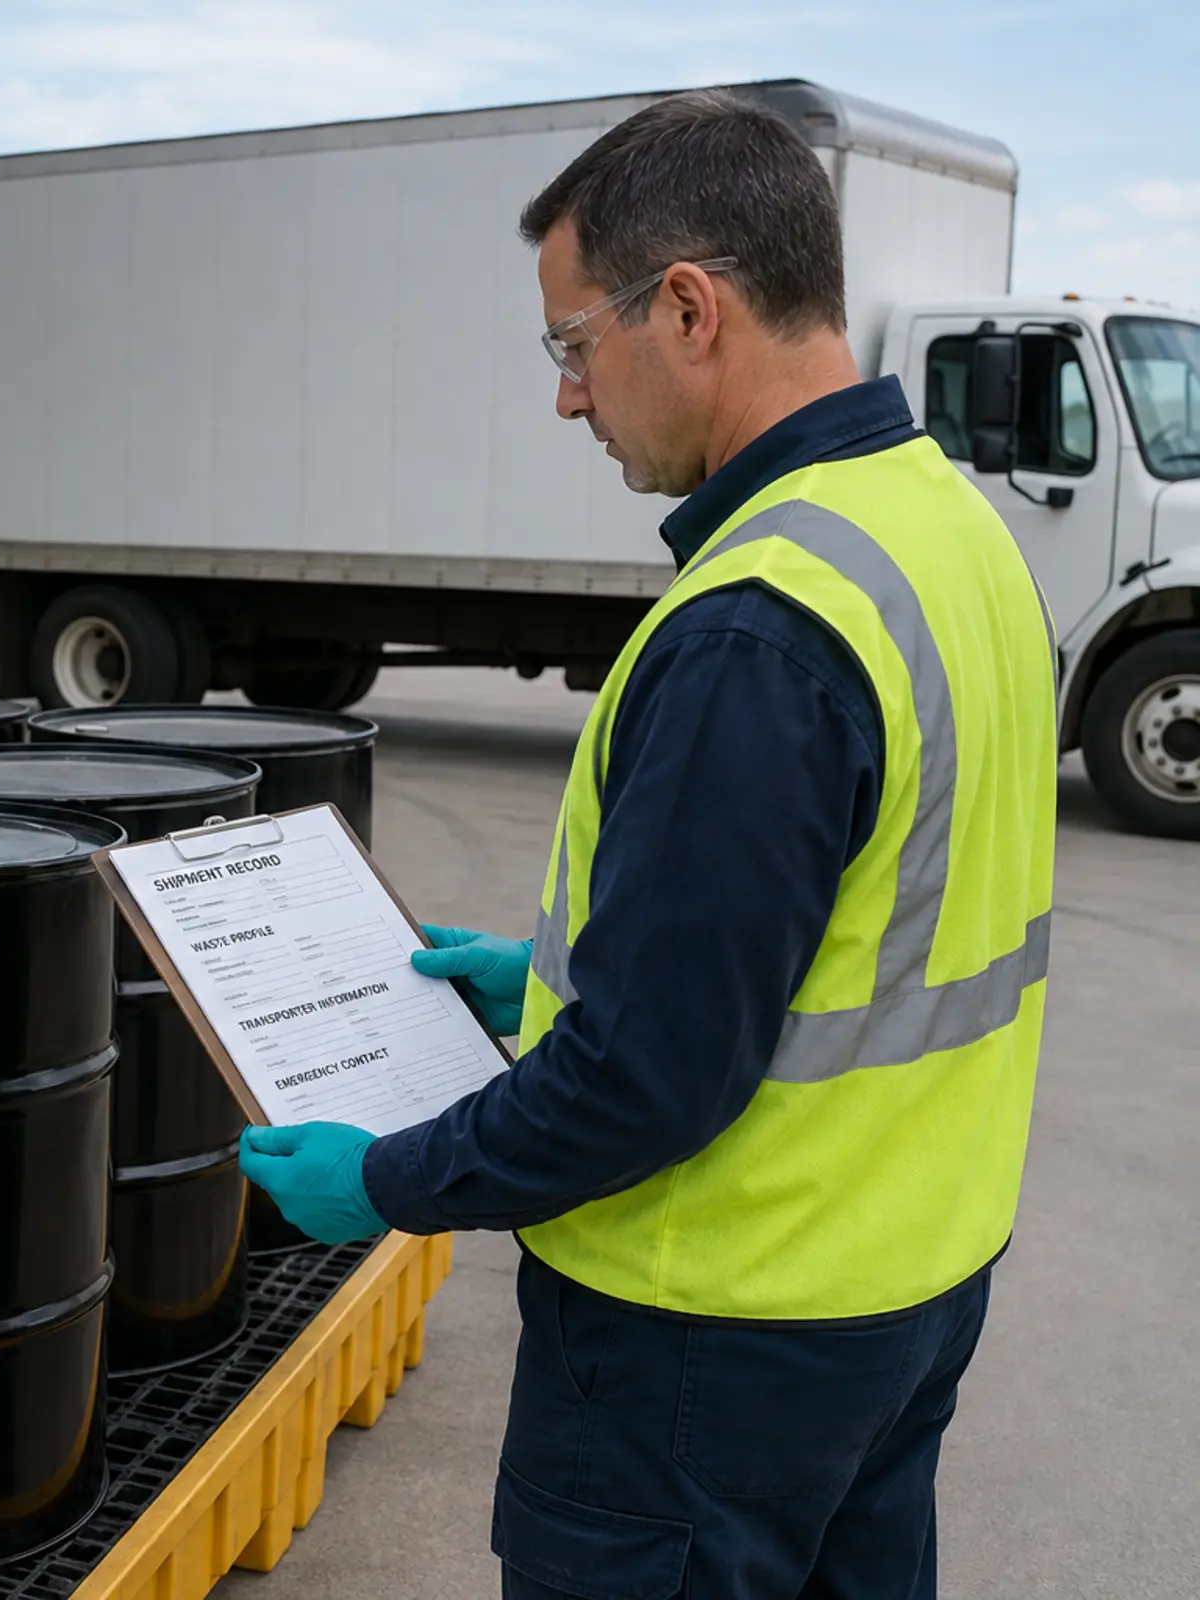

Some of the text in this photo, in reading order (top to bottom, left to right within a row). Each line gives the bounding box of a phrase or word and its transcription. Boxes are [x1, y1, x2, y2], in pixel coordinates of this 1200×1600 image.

[153, 854, 281, 892] SHIPMENT RECORD
[190, 936, 230, 952] WASTE
[231, 925, 275, 944] PROFILE
[238, 1002, 316, 1031] TRANSPORTER
[317, 982, 390, 1010] INFORMATION
[340, 1047, 390, 1070] CONTACT
